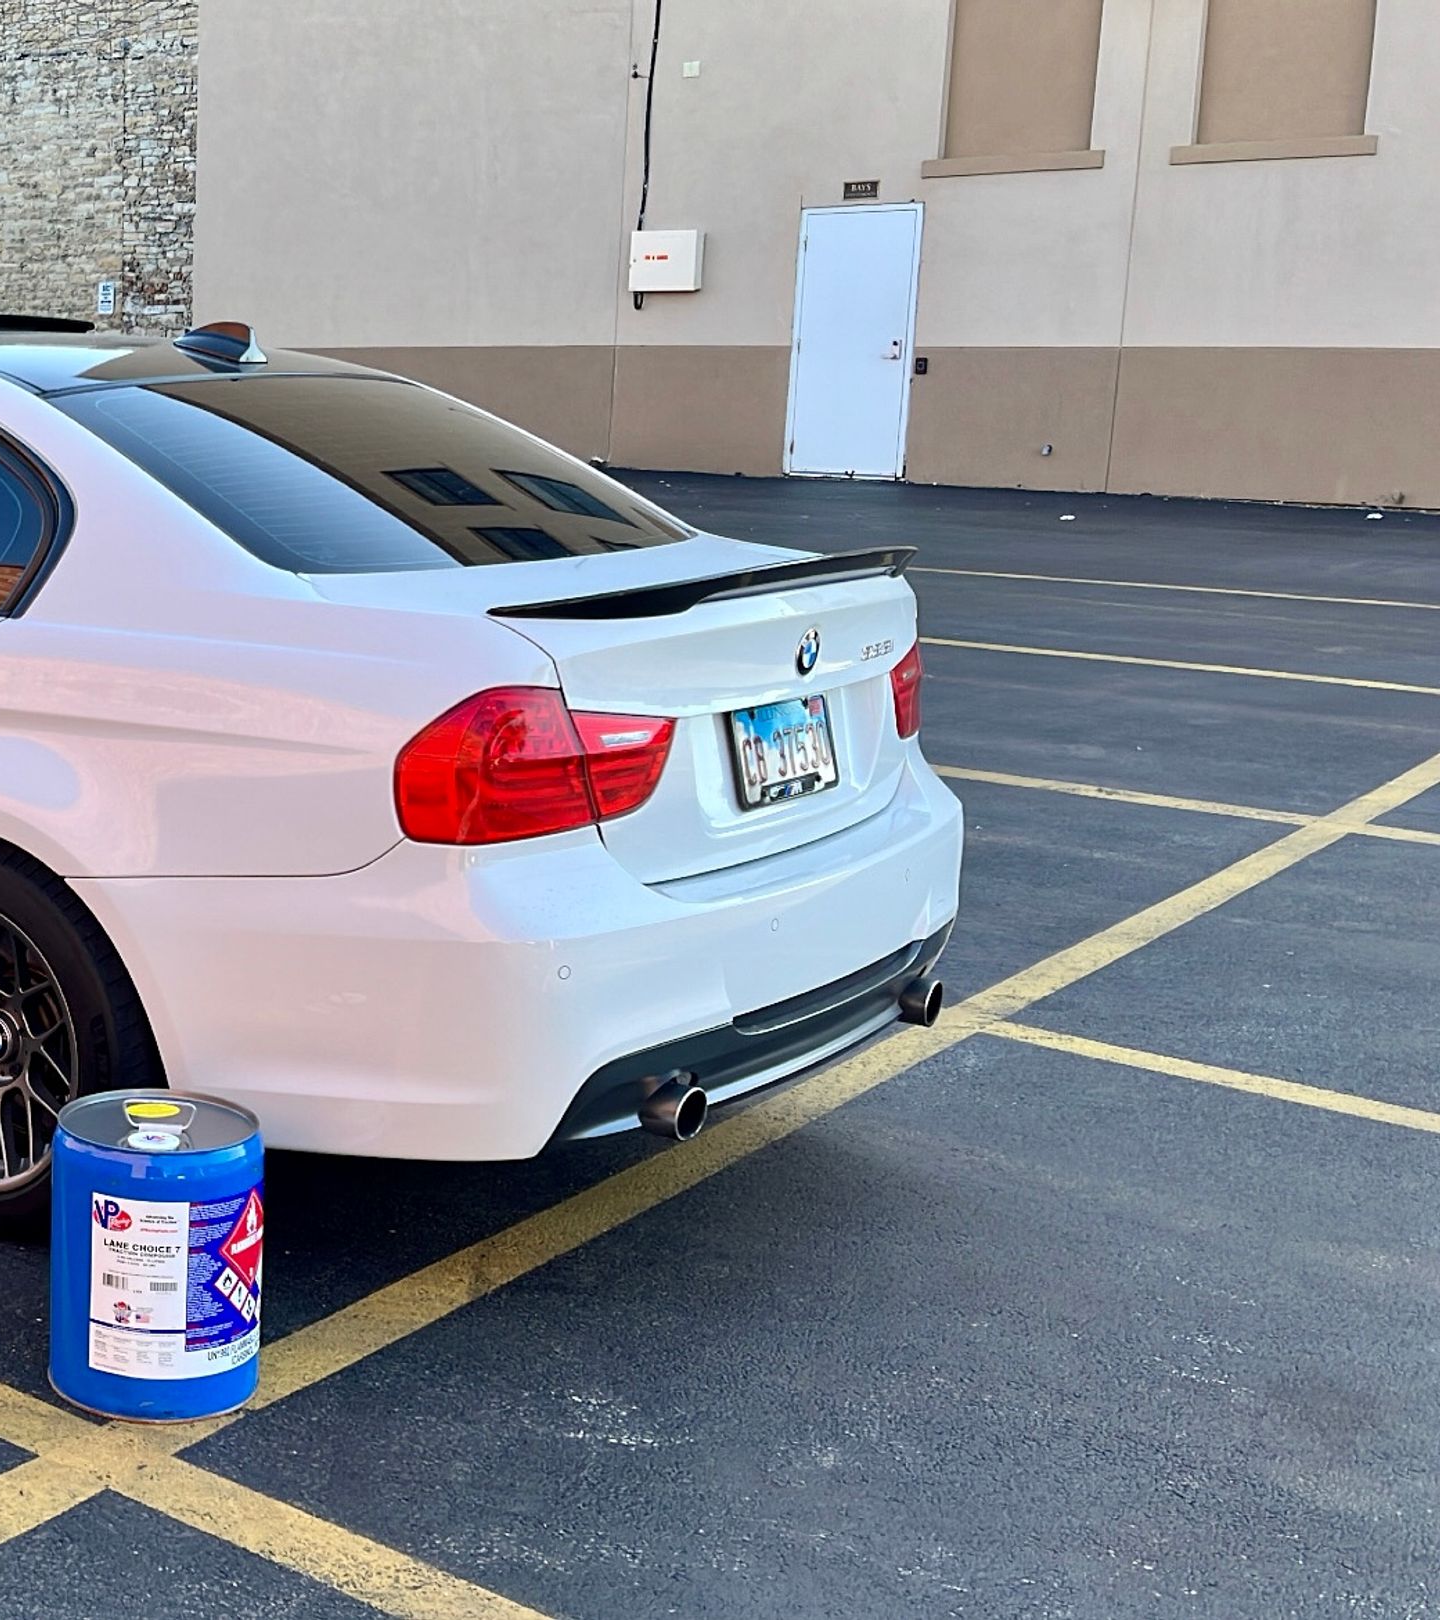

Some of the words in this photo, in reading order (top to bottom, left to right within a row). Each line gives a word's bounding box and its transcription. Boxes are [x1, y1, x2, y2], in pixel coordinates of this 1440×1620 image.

[742, 736, 768, 787] CB
[772, 719, 832, 777] 37530
[94, 1199, 120, 1230] VP
[103, 1238, 129, 1249] LANE
[131, 1244, 171, 1253] CHOICE
